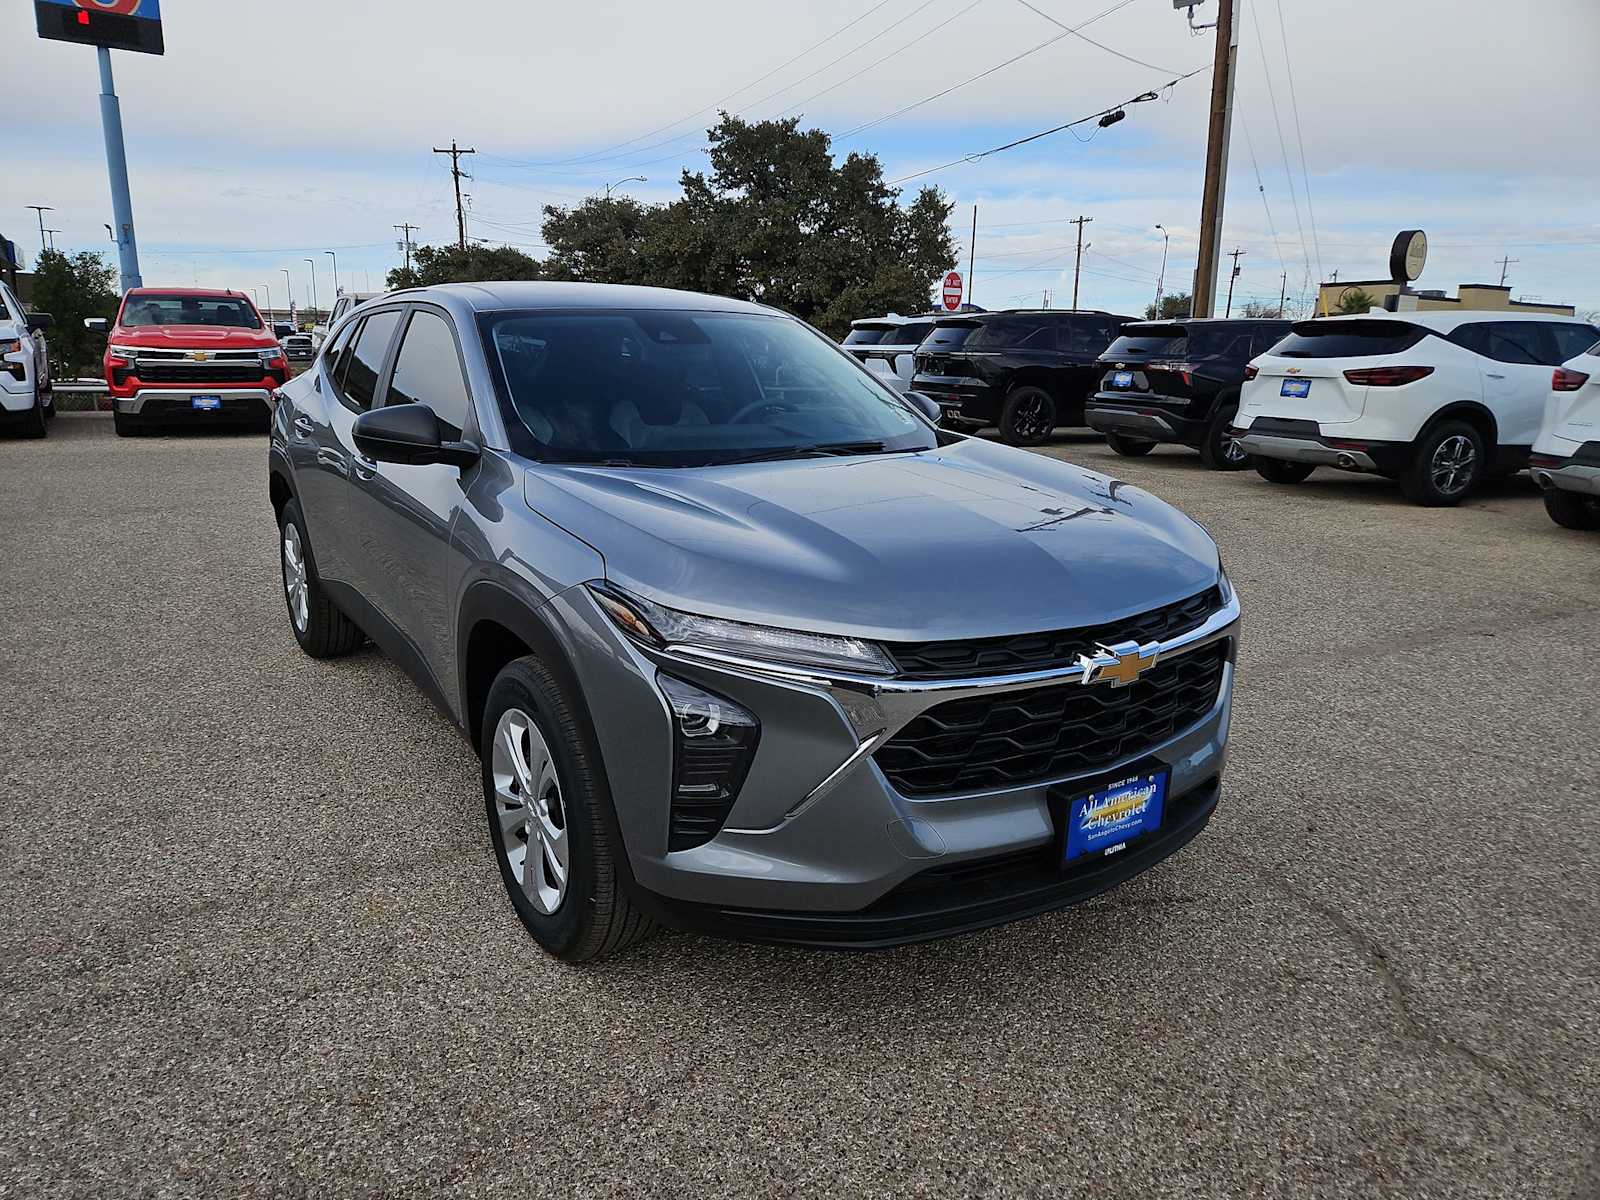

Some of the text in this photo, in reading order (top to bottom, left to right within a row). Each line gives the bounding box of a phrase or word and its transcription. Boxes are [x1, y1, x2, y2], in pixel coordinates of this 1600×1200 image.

[945, 279, 952, 287] DO
[945, 296, 958, 304] ENTER
[1108, 779, 1126, 790] SINCE
[1079, 784, 1157, 818] All American
[1088, 801, 1146, 830] Chevrolet
